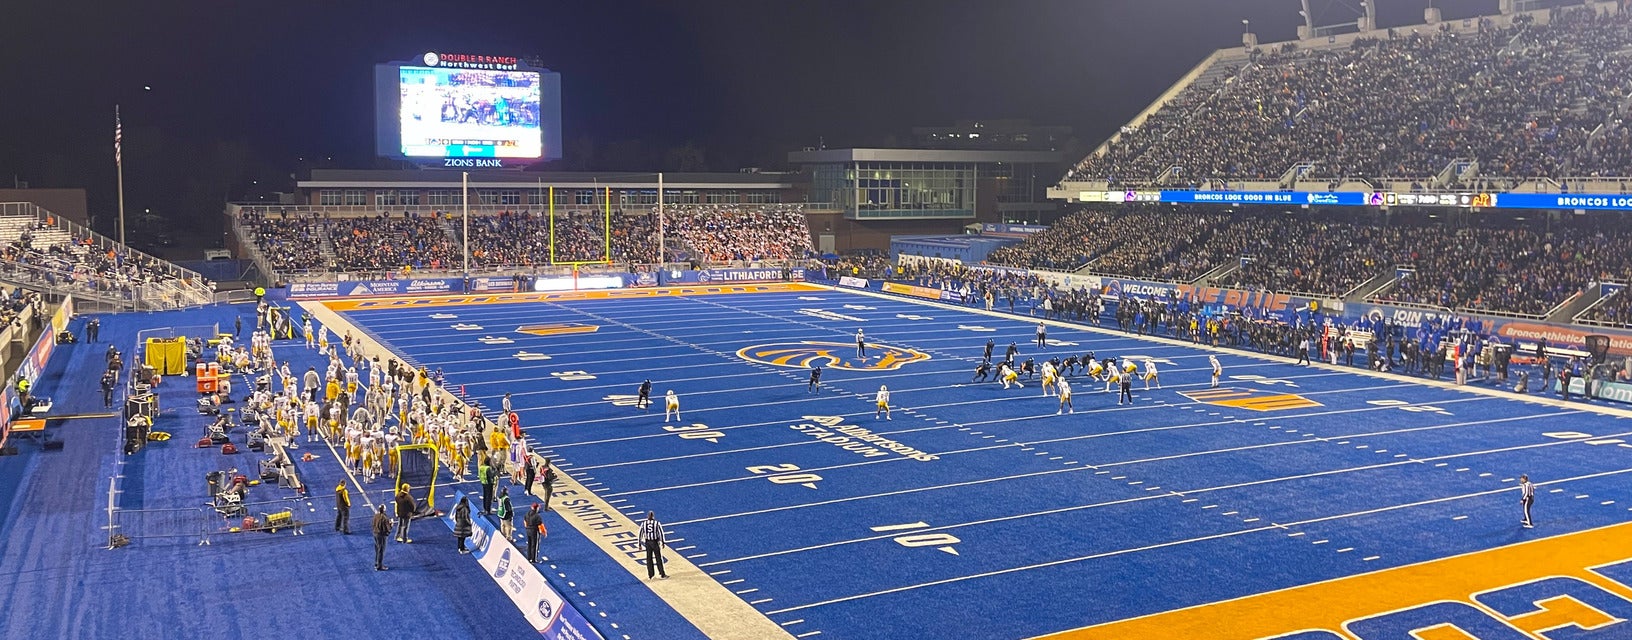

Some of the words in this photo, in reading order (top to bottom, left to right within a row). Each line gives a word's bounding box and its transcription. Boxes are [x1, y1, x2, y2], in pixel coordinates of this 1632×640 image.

[440, 61, 493, 69] Northwest
[441, 53, 476, 62] DOUBLE
[486, 56, 516, 64] RANCH
[444, 158, 474, 167] ZIONS
[476, 159, 502, 167] BANK
[1225, 193, 1242, 201] LOOK
[1275, 194, 1292, 202] BLUE
[1557, 197, 1608, 207] BRONCOS
[1123, 283, 1166, 298] WELCOME
[1176, 286, 1221, 303] THE
[1394, 309, 1423, 323] JOIN
[662, 423, 726, 440] 30
[790, 424, 889, 458] STADIUM
[836, 424, 940, 462] Albertsons
[745, 463, 823, 485] 20
[561, 498, 622, 531] SMITH
[647, 524, 654, 533] S
[870, 521, 961, 547] 10
